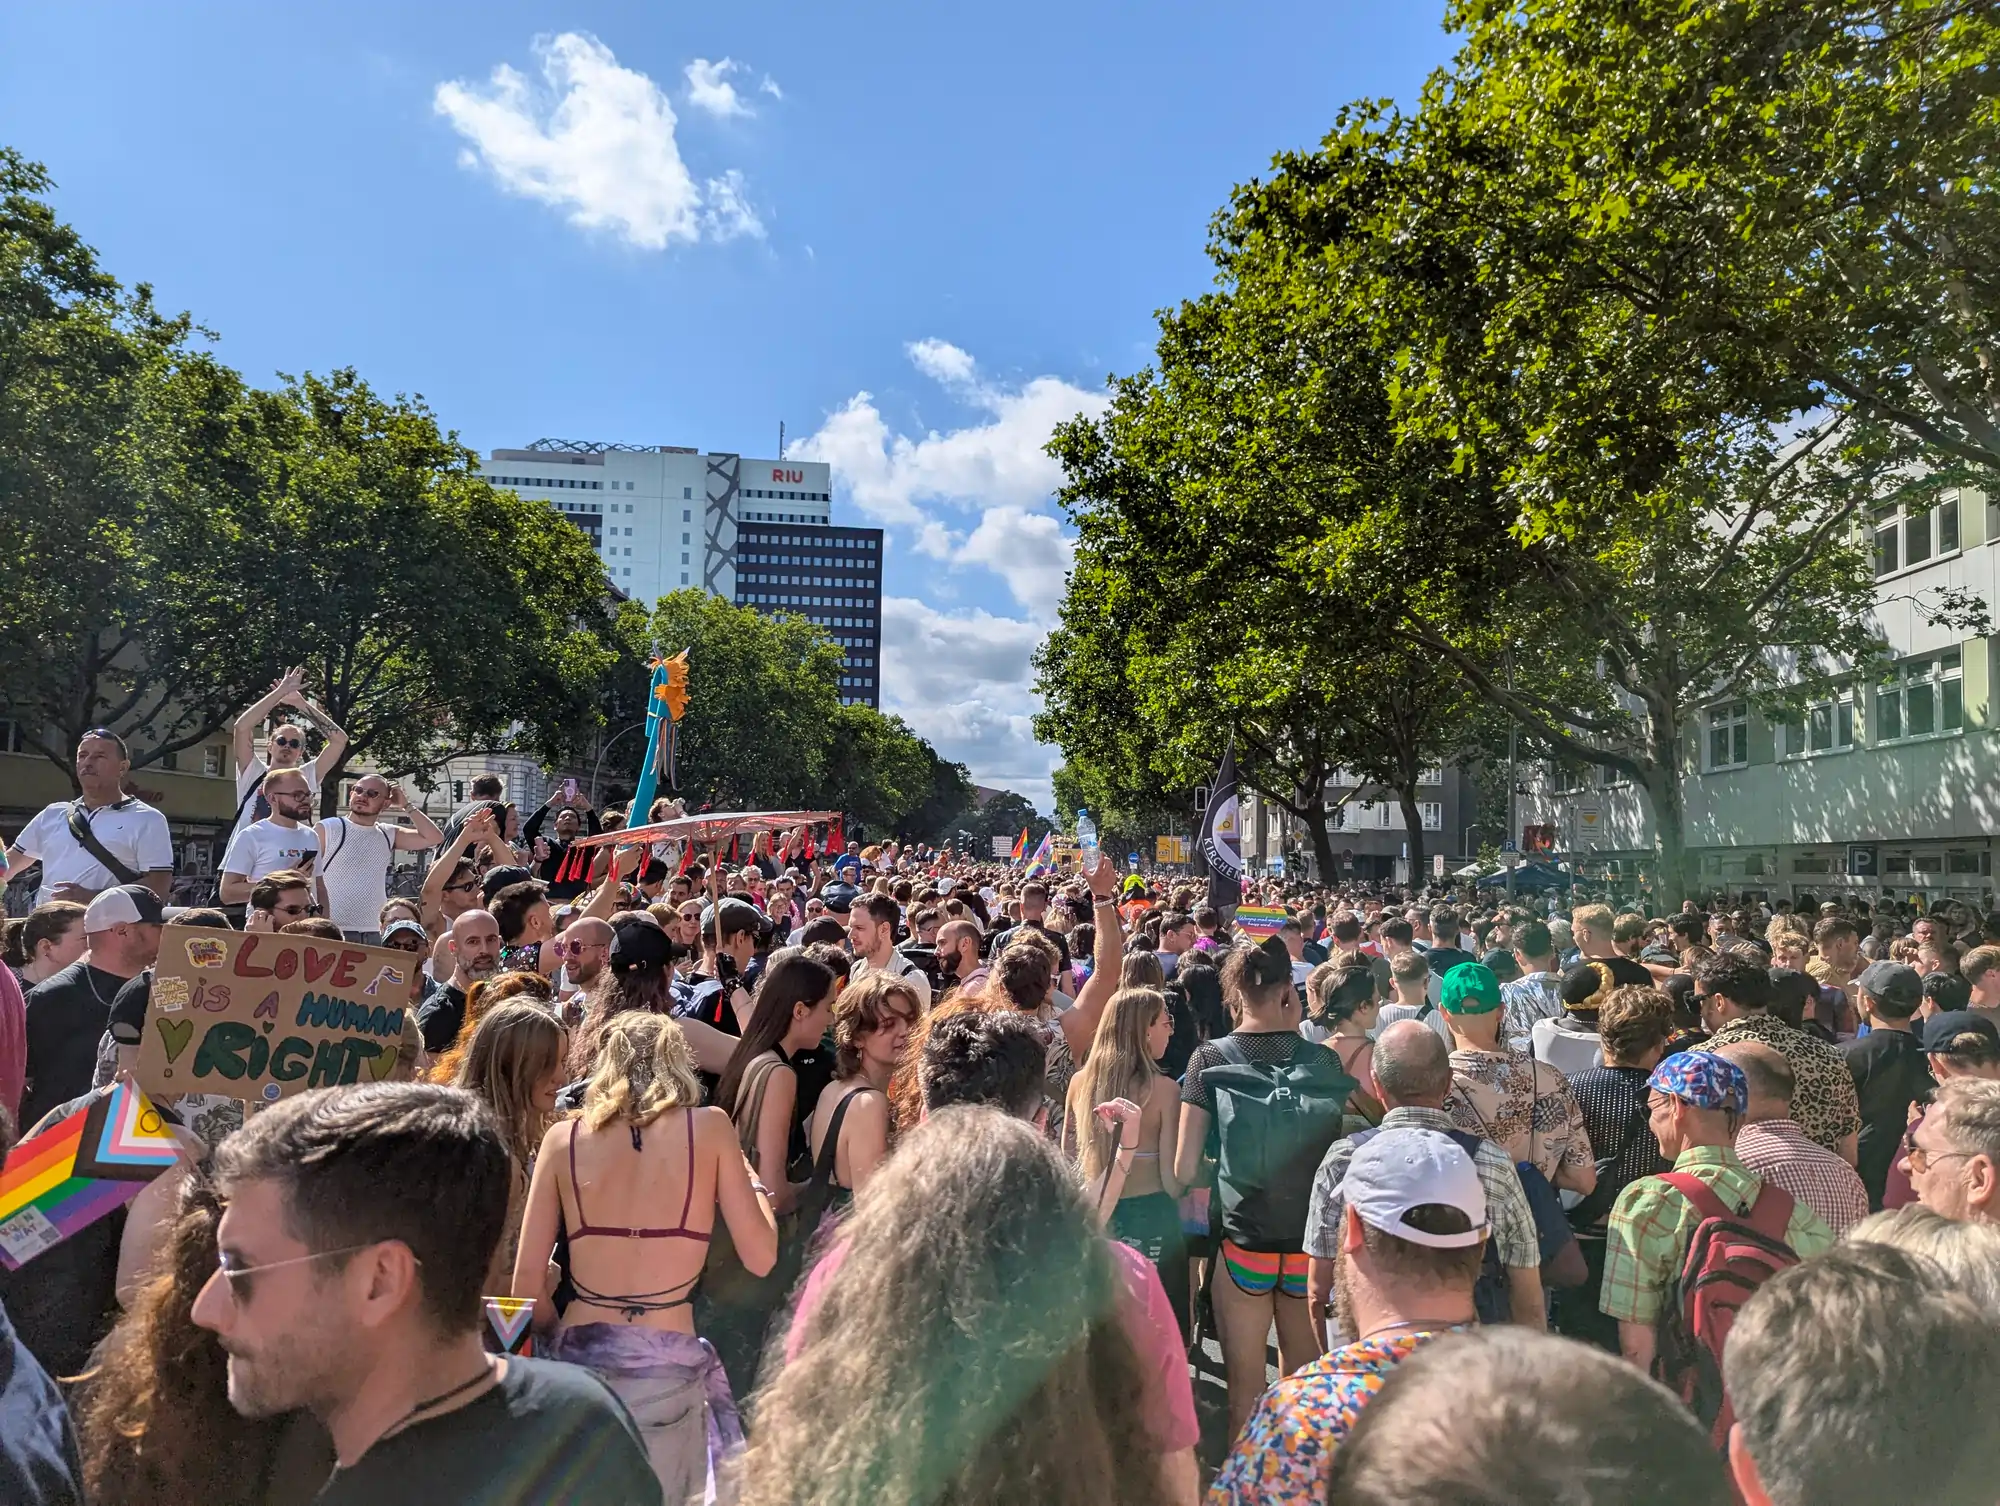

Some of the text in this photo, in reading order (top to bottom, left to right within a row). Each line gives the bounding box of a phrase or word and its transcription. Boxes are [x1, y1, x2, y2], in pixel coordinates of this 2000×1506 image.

[772, 468, 803, 483] RIU
[1204, 837, 1241, 881] KIRCHEN
[1854, 850, 1871, 874] P
[233, 934, 367, 988] LOVE
[253, 991, 280, 1019] A
[296, 991, 404, 1037] HUMAN
